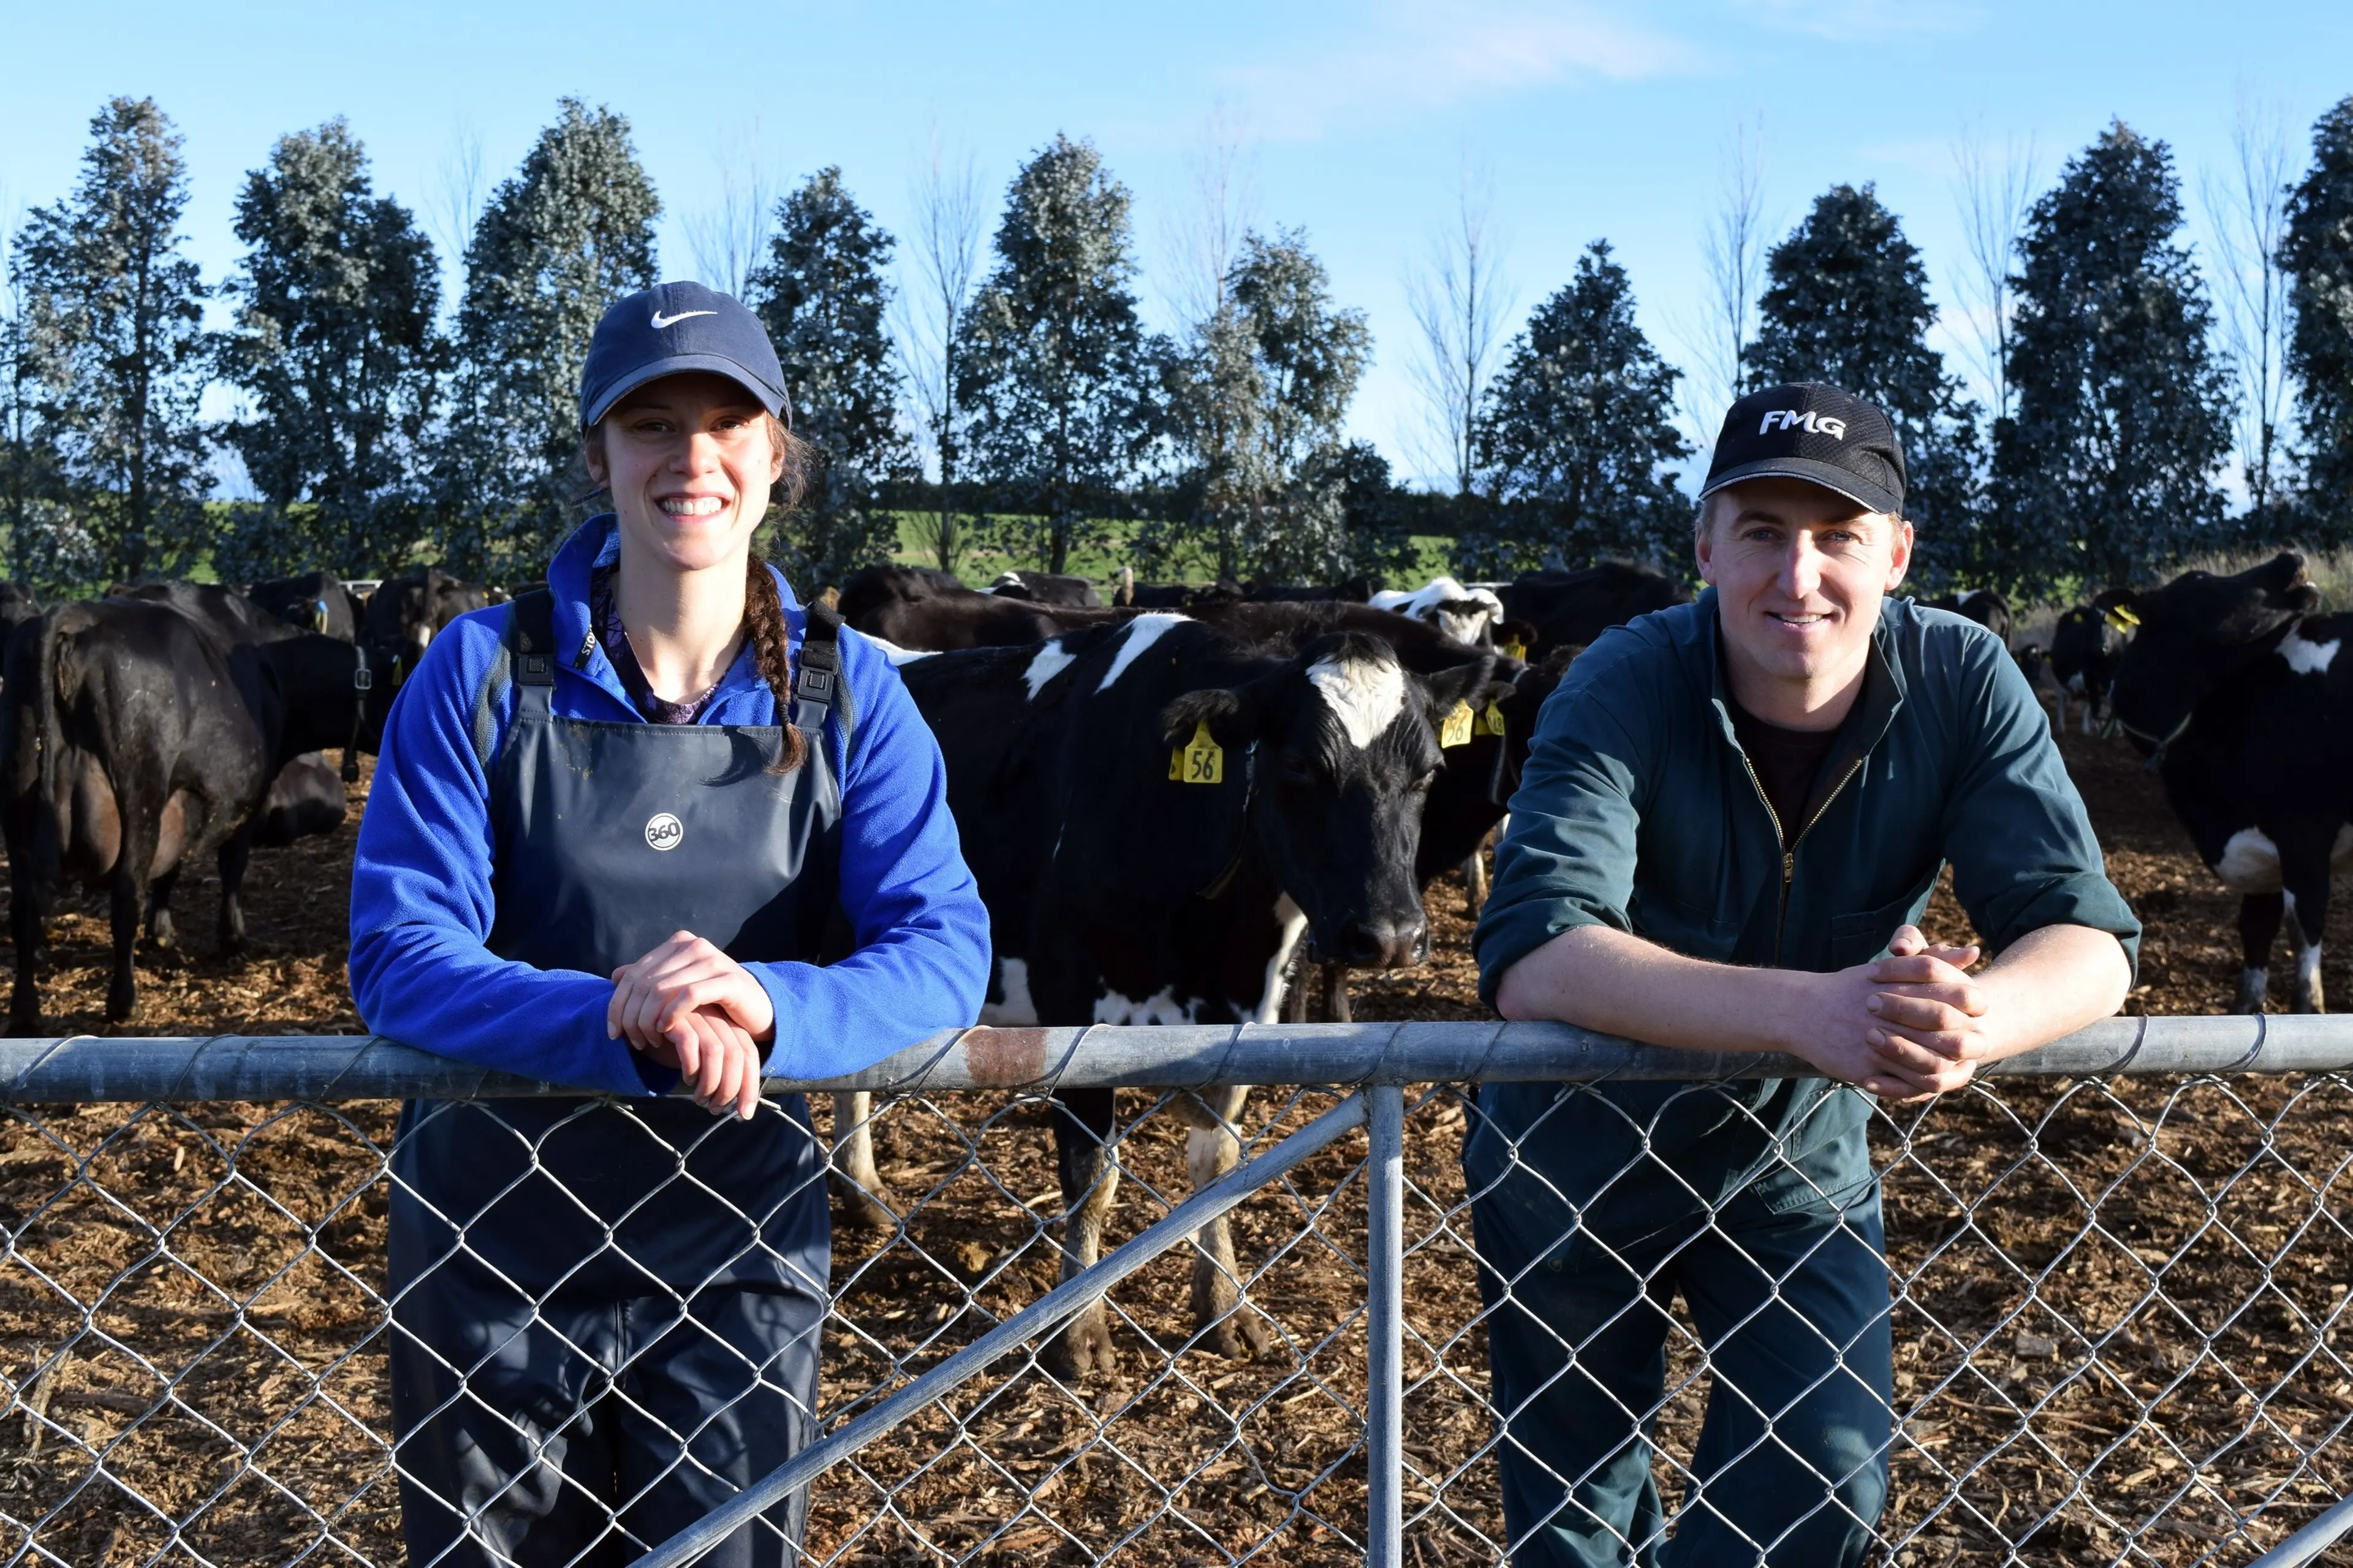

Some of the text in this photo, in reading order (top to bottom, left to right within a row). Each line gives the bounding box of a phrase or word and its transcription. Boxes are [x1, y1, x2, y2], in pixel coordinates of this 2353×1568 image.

[1759, 410, 1846, 441] FMG
[582, 624, 596, 656] STO
[1192, 750, 1214, 780] 56
[648, 822, 681, 842] 360
